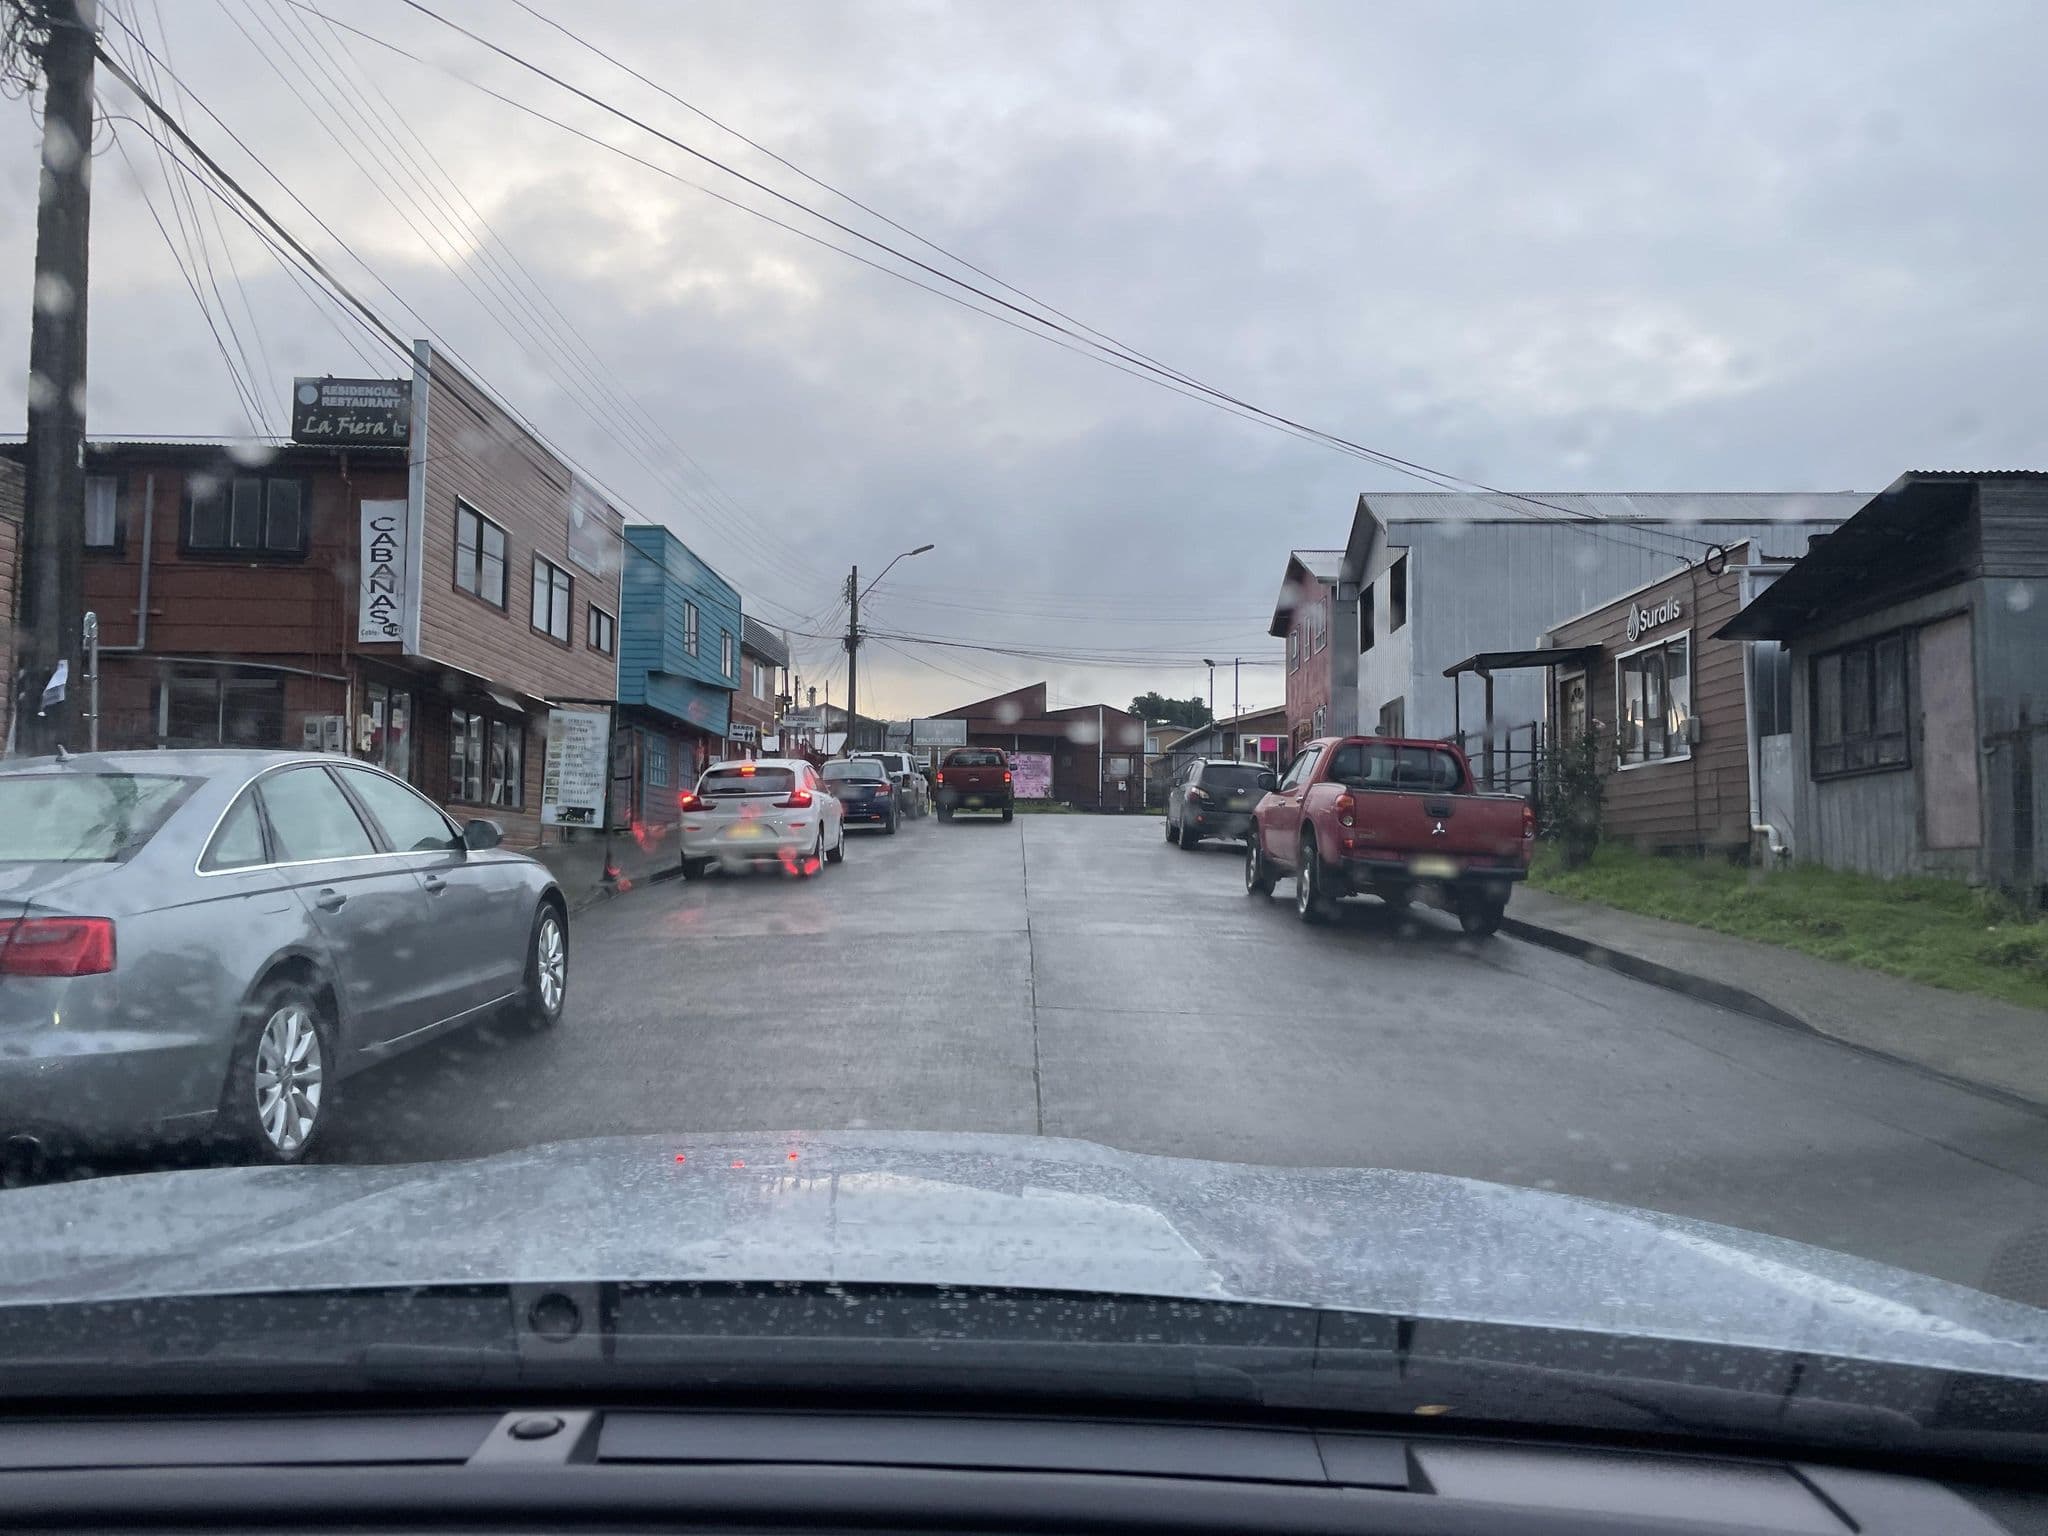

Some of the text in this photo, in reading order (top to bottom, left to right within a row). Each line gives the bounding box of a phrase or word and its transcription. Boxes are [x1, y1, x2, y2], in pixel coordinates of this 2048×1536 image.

[322, 386, 401, 397] RESIDENCIAL
[322, 397, 401, 408] RESTAURANT
[302, 415, 387, 436] La Fiera
[1640, 596, 1680, 631] Suralis
